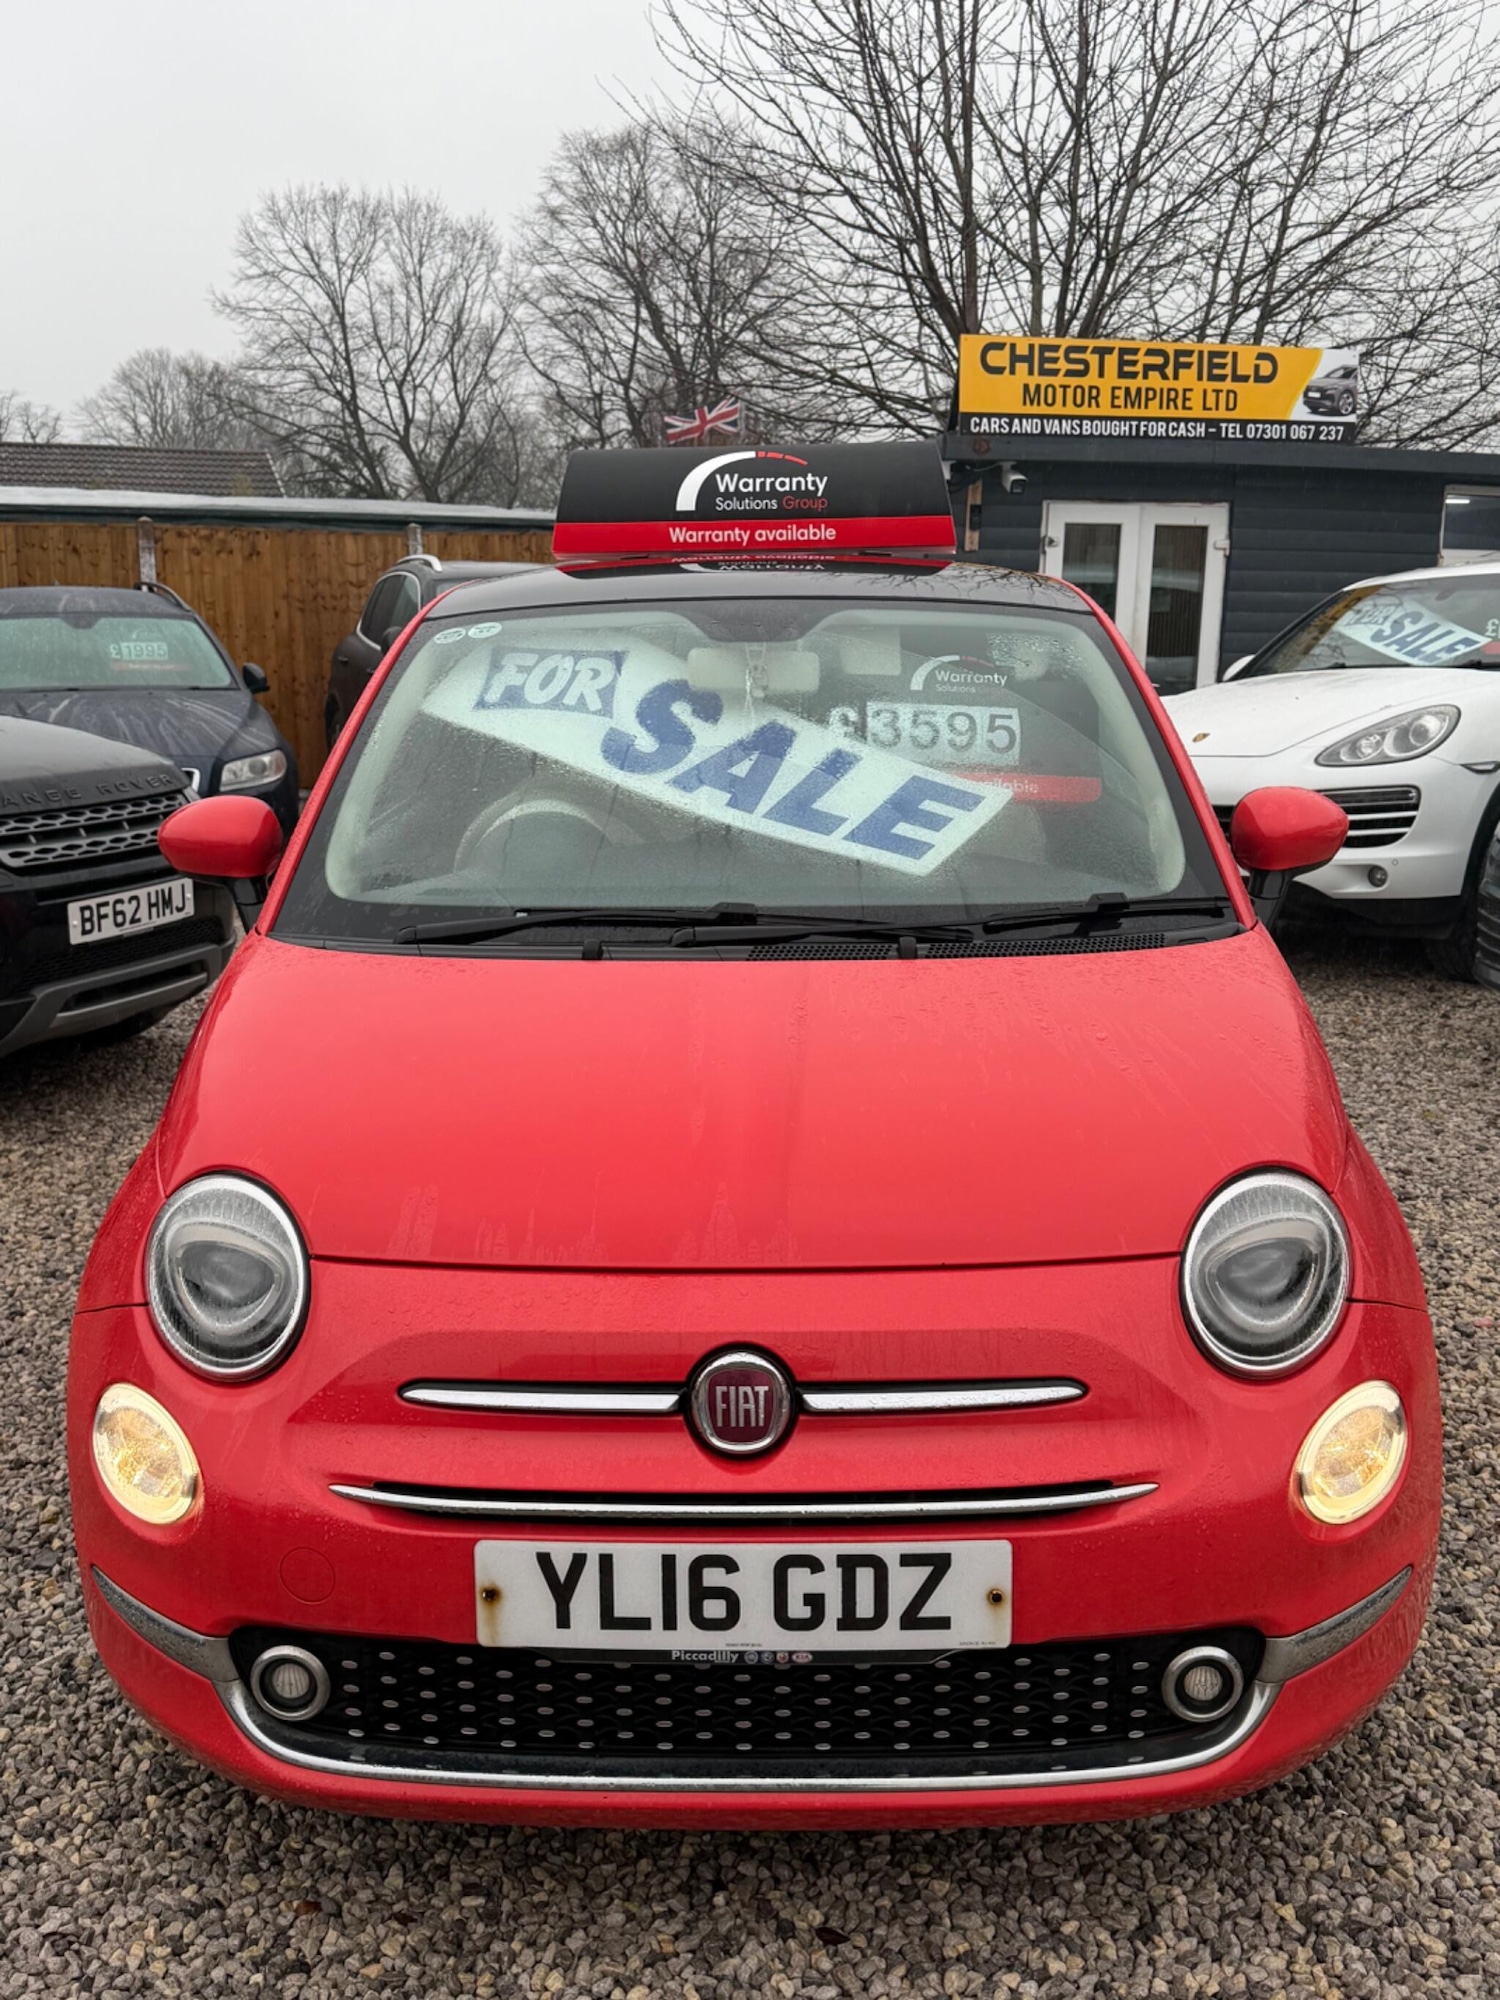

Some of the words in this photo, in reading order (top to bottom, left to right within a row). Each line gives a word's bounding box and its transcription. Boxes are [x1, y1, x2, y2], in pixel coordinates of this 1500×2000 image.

[980, 341, 1279, 384] CHESTERFIELD
[1022, 383, 1101, 409] MOTOR
[1110, 386, 1194, 411] EMPIRE
[1202, 388, 1238, 412] LTD
[970, 417, 1010, 434] CARS
[1011, 418, 1042, 434] AND
[1043, 419, 1081, 435] VANS
[1082, 420, 1138, 436] BOUGHT
[1140, 421, 1166, 437] FOR
[1168, 422, 1206, 437] CASH
[1219, 423, 1243, 438] TEL
[1246, 423, 1287, 440] 07301
[1290, 424, 1316, 440] 067
[1319, 425, 1345, 441] 237
[715, 473, 828, 497] Warranty
[715, 497, 778, 511] Solutions
[782, 495, 828, 512] Group
[668, 527, 750, 546] Warranty
[754, 524, 837, 542] available
[1370, 611, 1482, 663] SALE
[484, 652, 616, 711] FOR
[935, 669, 1008, 687] Warranty
[935, 683, 976, 693] Solutions
[600, 679, 986, 861] SALE
[79, 894, 142, 936] BF62
[147, 883, 186, 920] HMJ
[715, 1385, 769, 1427] FIAT
[535, 1551, 741, 1633] YL16
[772, 1553, 952, 1633] GDZ
[671, 1650, 739, 1662] Piccadilly
